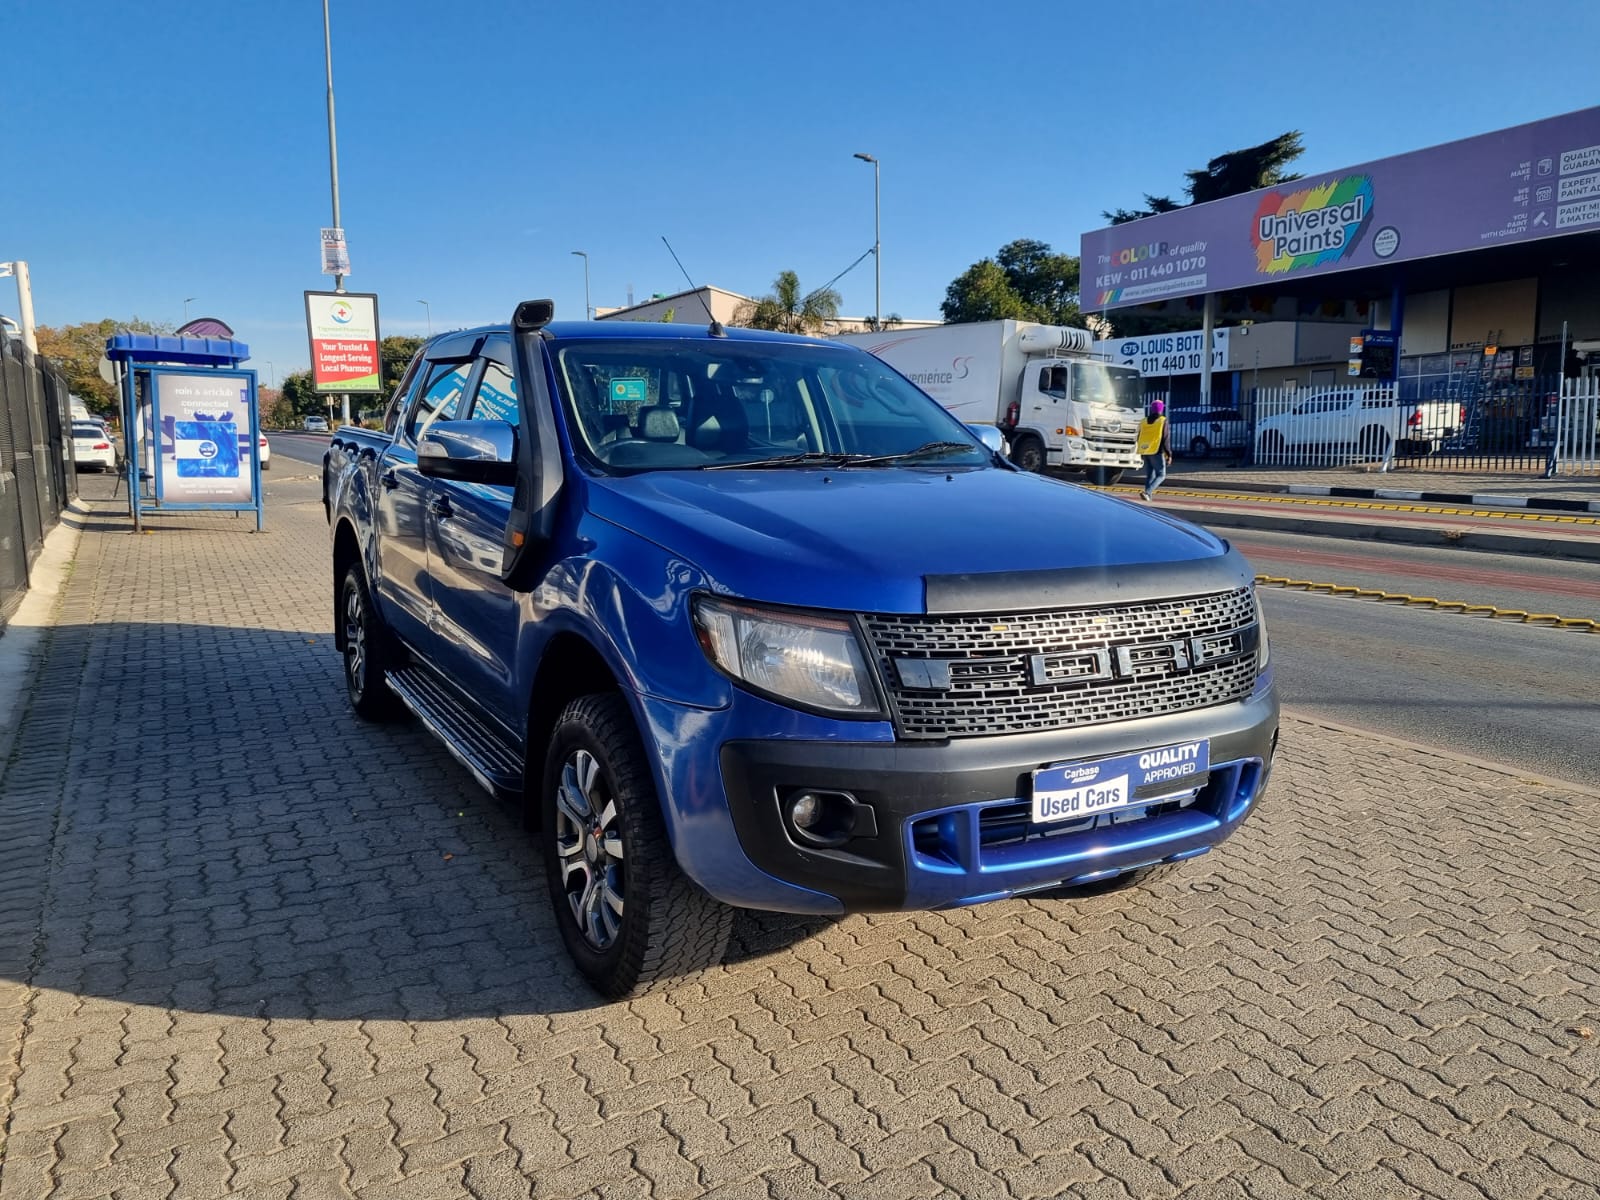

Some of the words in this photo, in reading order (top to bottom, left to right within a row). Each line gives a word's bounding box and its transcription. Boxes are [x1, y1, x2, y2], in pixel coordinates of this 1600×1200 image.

[1561, 176, 1597, 189] EXPERT
[1561, 186, 1588, 198] PAINT
[1560, 205, 1586, 215] PAINT
[1261, 197, 1362, 239] Universal
[1275, 228, 1343, 257] Paints
[1098, 255, 1110, 264] The
[1111, 242, 1169, 267] COLOUR
[1170, 245, 1179, 257] of
[1180, 241, 1208, 256] quality
[1095, 272, 1122, 289] KEW
[1131, 267, 1148, 281] 011
[1150, 263, 1173, 277] 440
[1176, 256, 1206, 273] 1070
[321, 342, 337, 351] Your
[338, 342, 362, 351] Trusted
[363, 343, 369, 351] &
[1140, 338, 1173, 355] LOUIS
[320, 352, 346, 363] Longest
[347, 353, 373, 364] Serving
[1141, 357, 1159, 373] 011
[1161, 355, 1185, 370] 440
[321, 364, 339, 372] Local
[340, 364, 373, 375] Pharmacy
[181, 400, 229, 408] connected
[183, 407, 195, 417] by
[1138, 742, 1201, 770] QUALITY
[1064, 766, 1100, 780] Carbase
[1143, 762, 1196, 784] APPROVED
[1040, 791, 1080, 817] Used
[1085, 787, 1120, 808] Cars
